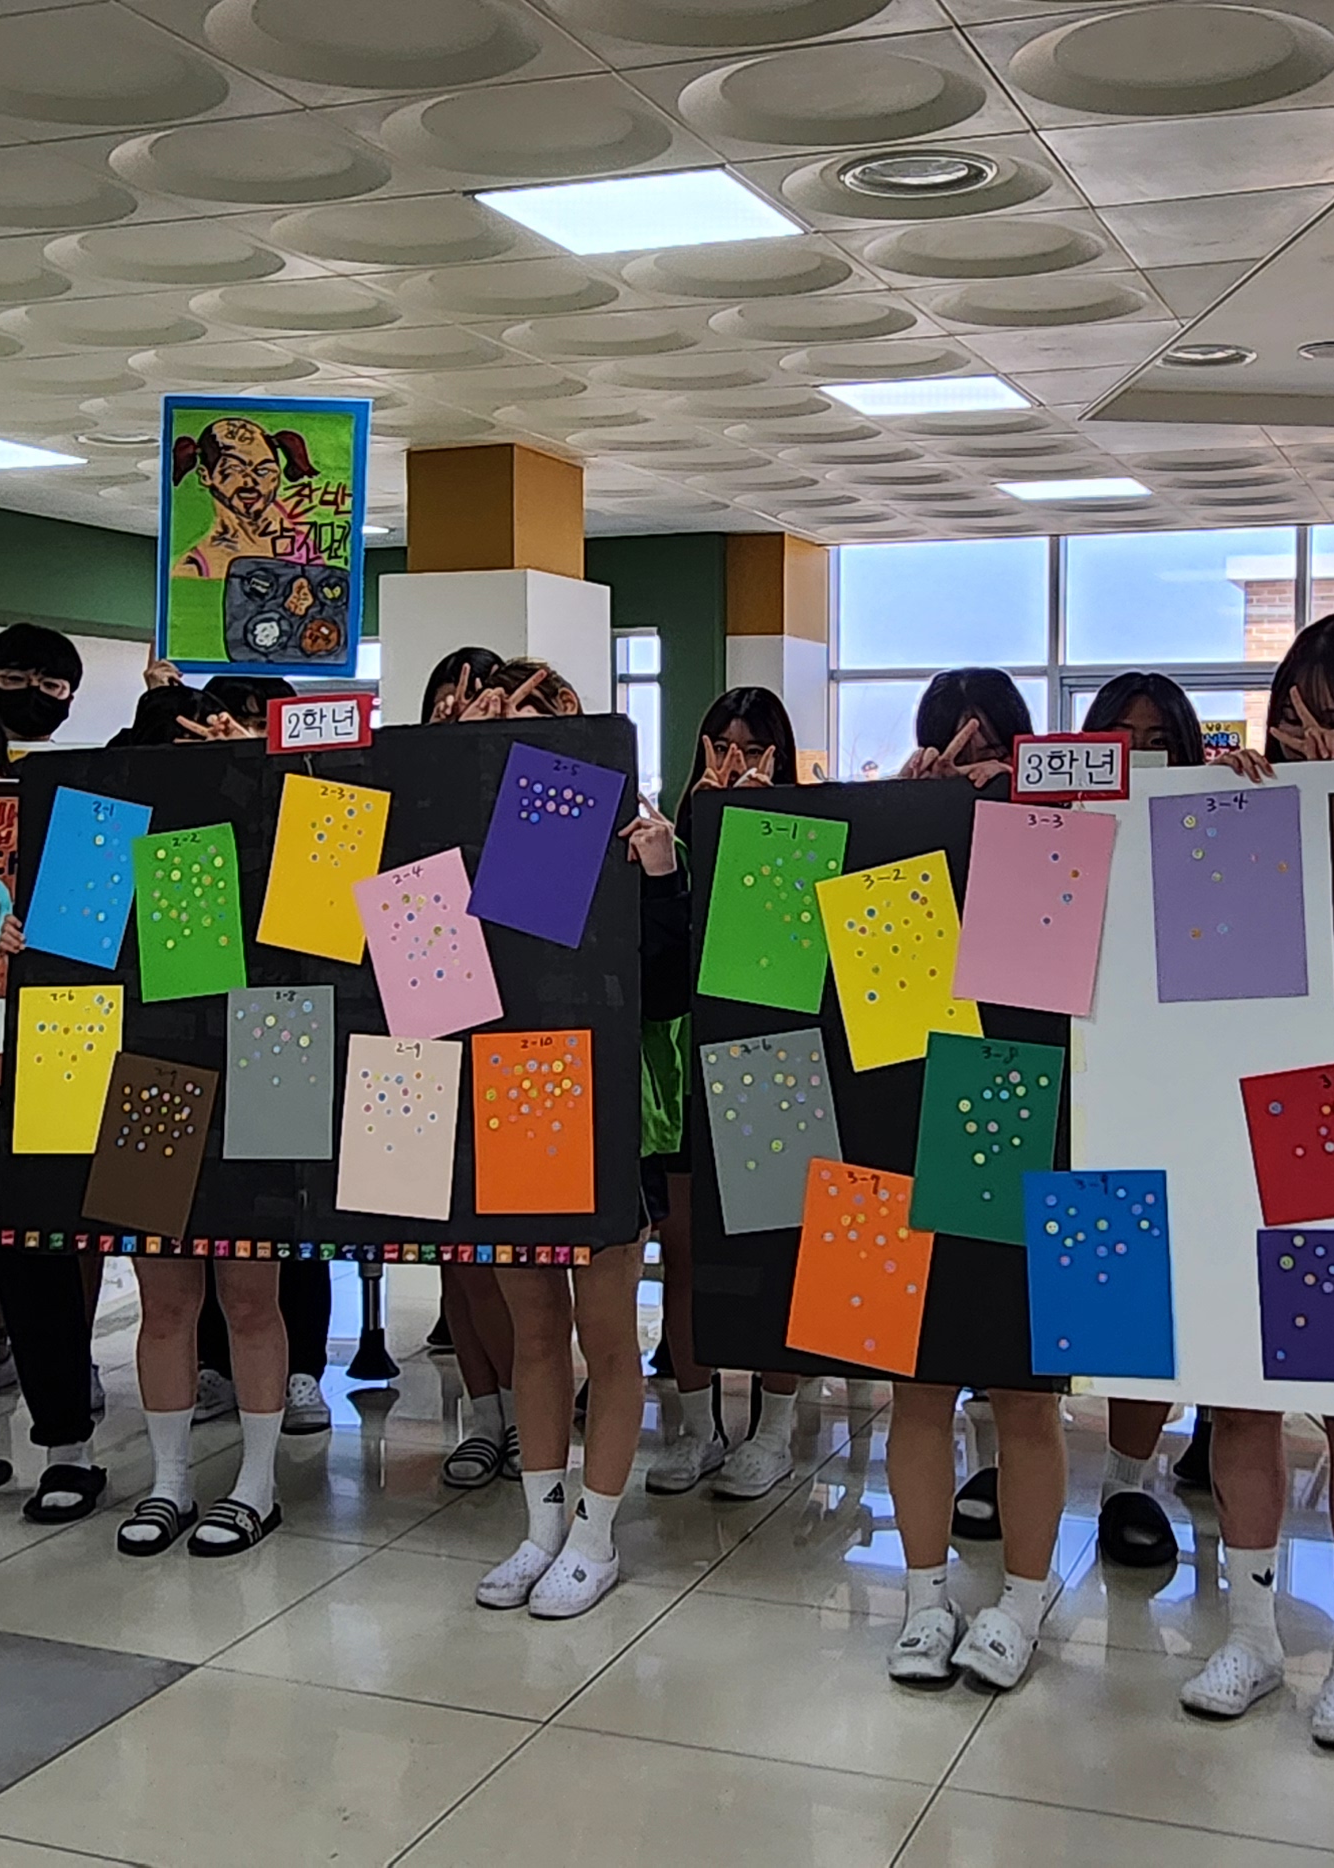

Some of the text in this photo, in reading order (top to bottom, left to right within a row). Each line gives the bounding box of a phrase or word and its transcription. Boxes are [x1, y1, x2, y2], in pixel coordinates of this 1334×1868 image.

[283, 481, 353, 519] 잔반
[287, 705, 355, 740] 2학년
[553, 759, 580, 776] 2-5
[1025, 748, 1115, 787] 3학년
[320, 785, 346, 800] 2-3
[1205, 791, 1249, 812] 3-4
[92, 800, 115, 817] 2-1
[1028, 812, 1065, 829] 3-3
[760, 820, 799, 841] 3-1
[171, 832, 202, 848] 2-2
[391, 865, 424, 885] 2-4
[861, 867, 907, 890] 3-2
[50, 989, 75, 1003] 2-6
[395, 1042, 422, 1058] 2-9
[520, 1036, 554, 1049] 2-10
[980, 1044, 1019, 1065] 3-8
